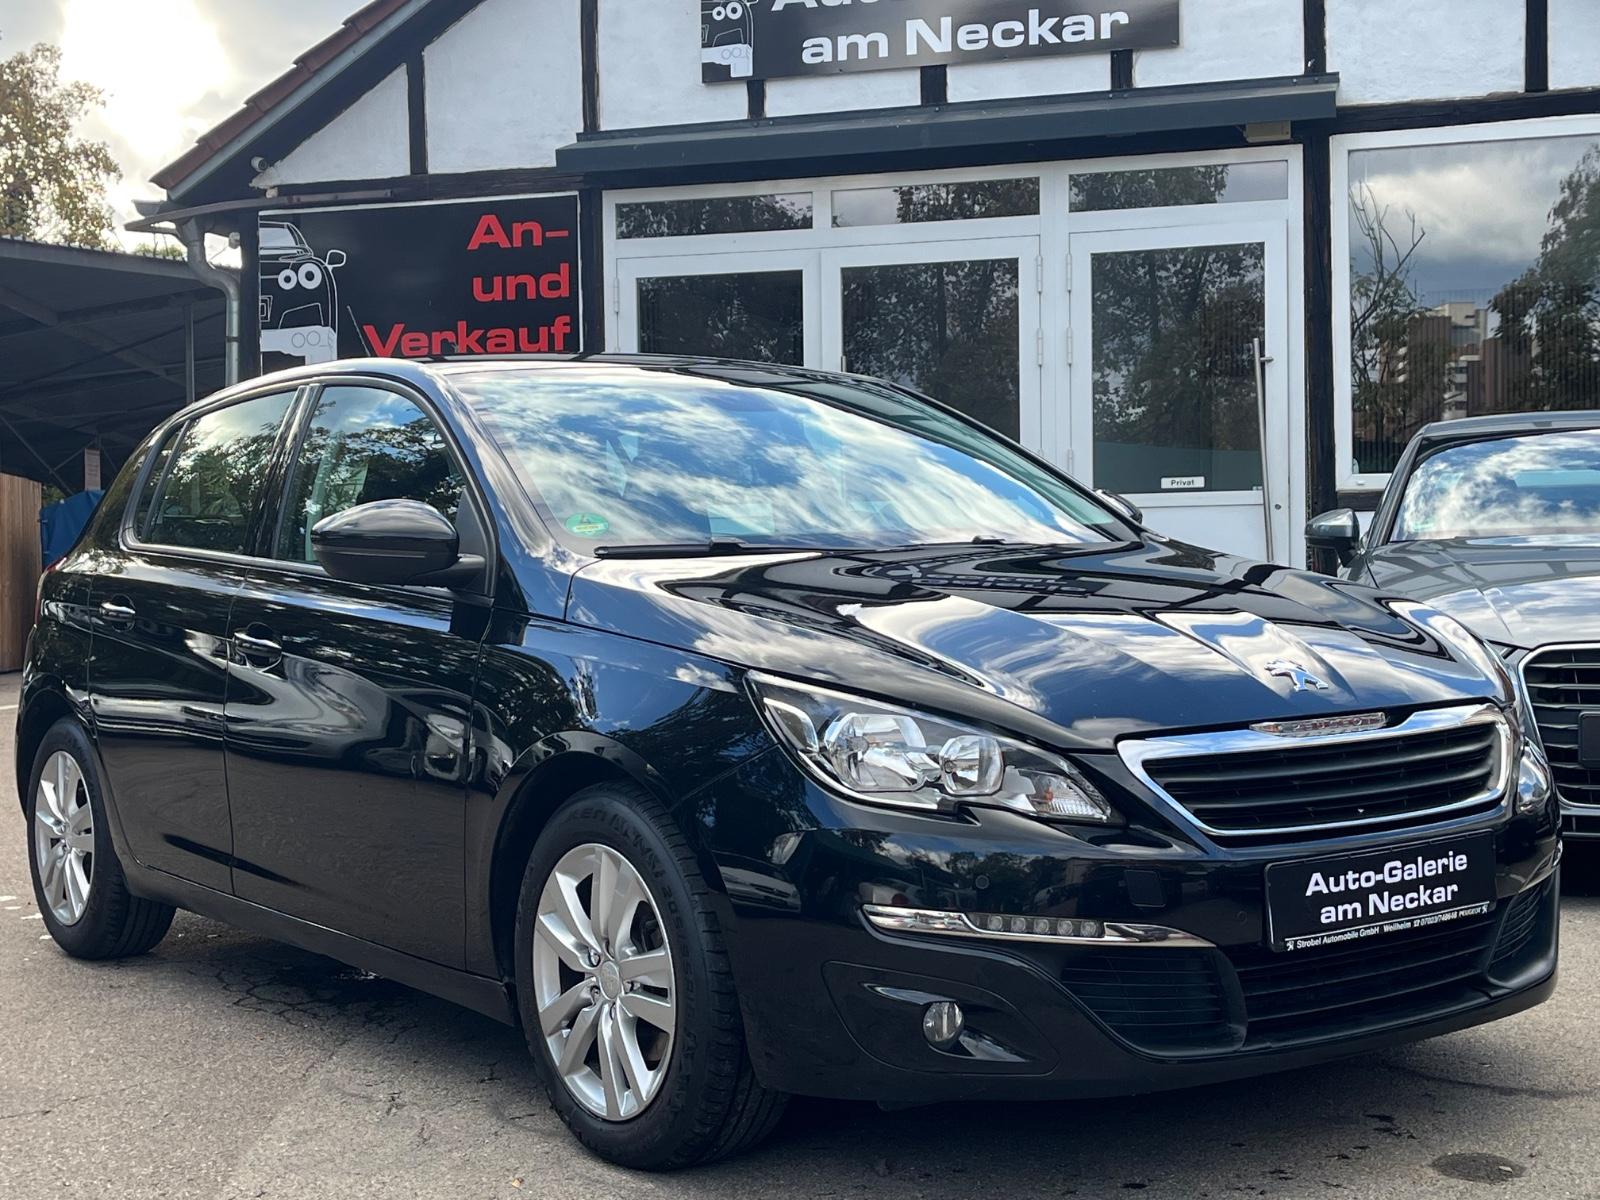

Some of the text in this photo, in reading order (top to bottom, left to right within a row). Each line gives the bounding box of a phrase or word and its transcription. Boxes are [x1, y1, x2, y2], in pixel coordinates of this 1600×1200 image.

[801, 8, 1130, 65] am Neckar
[467, 214, 569, 250] An-
[472, 263, 570, 302] und
[363, 315, 571, 359] Verkauf
[1170, 479, 1195, 487] Privat
[1305, 851, 1468, 897] Auto-Galerie
[1320, 883, 1459, 924] am Neckar
[1296, 937, 1321, 949] Strobel
[1322, 930, 1359, 945] Automobile
[1359, 926, 1380, 938] GmbH
